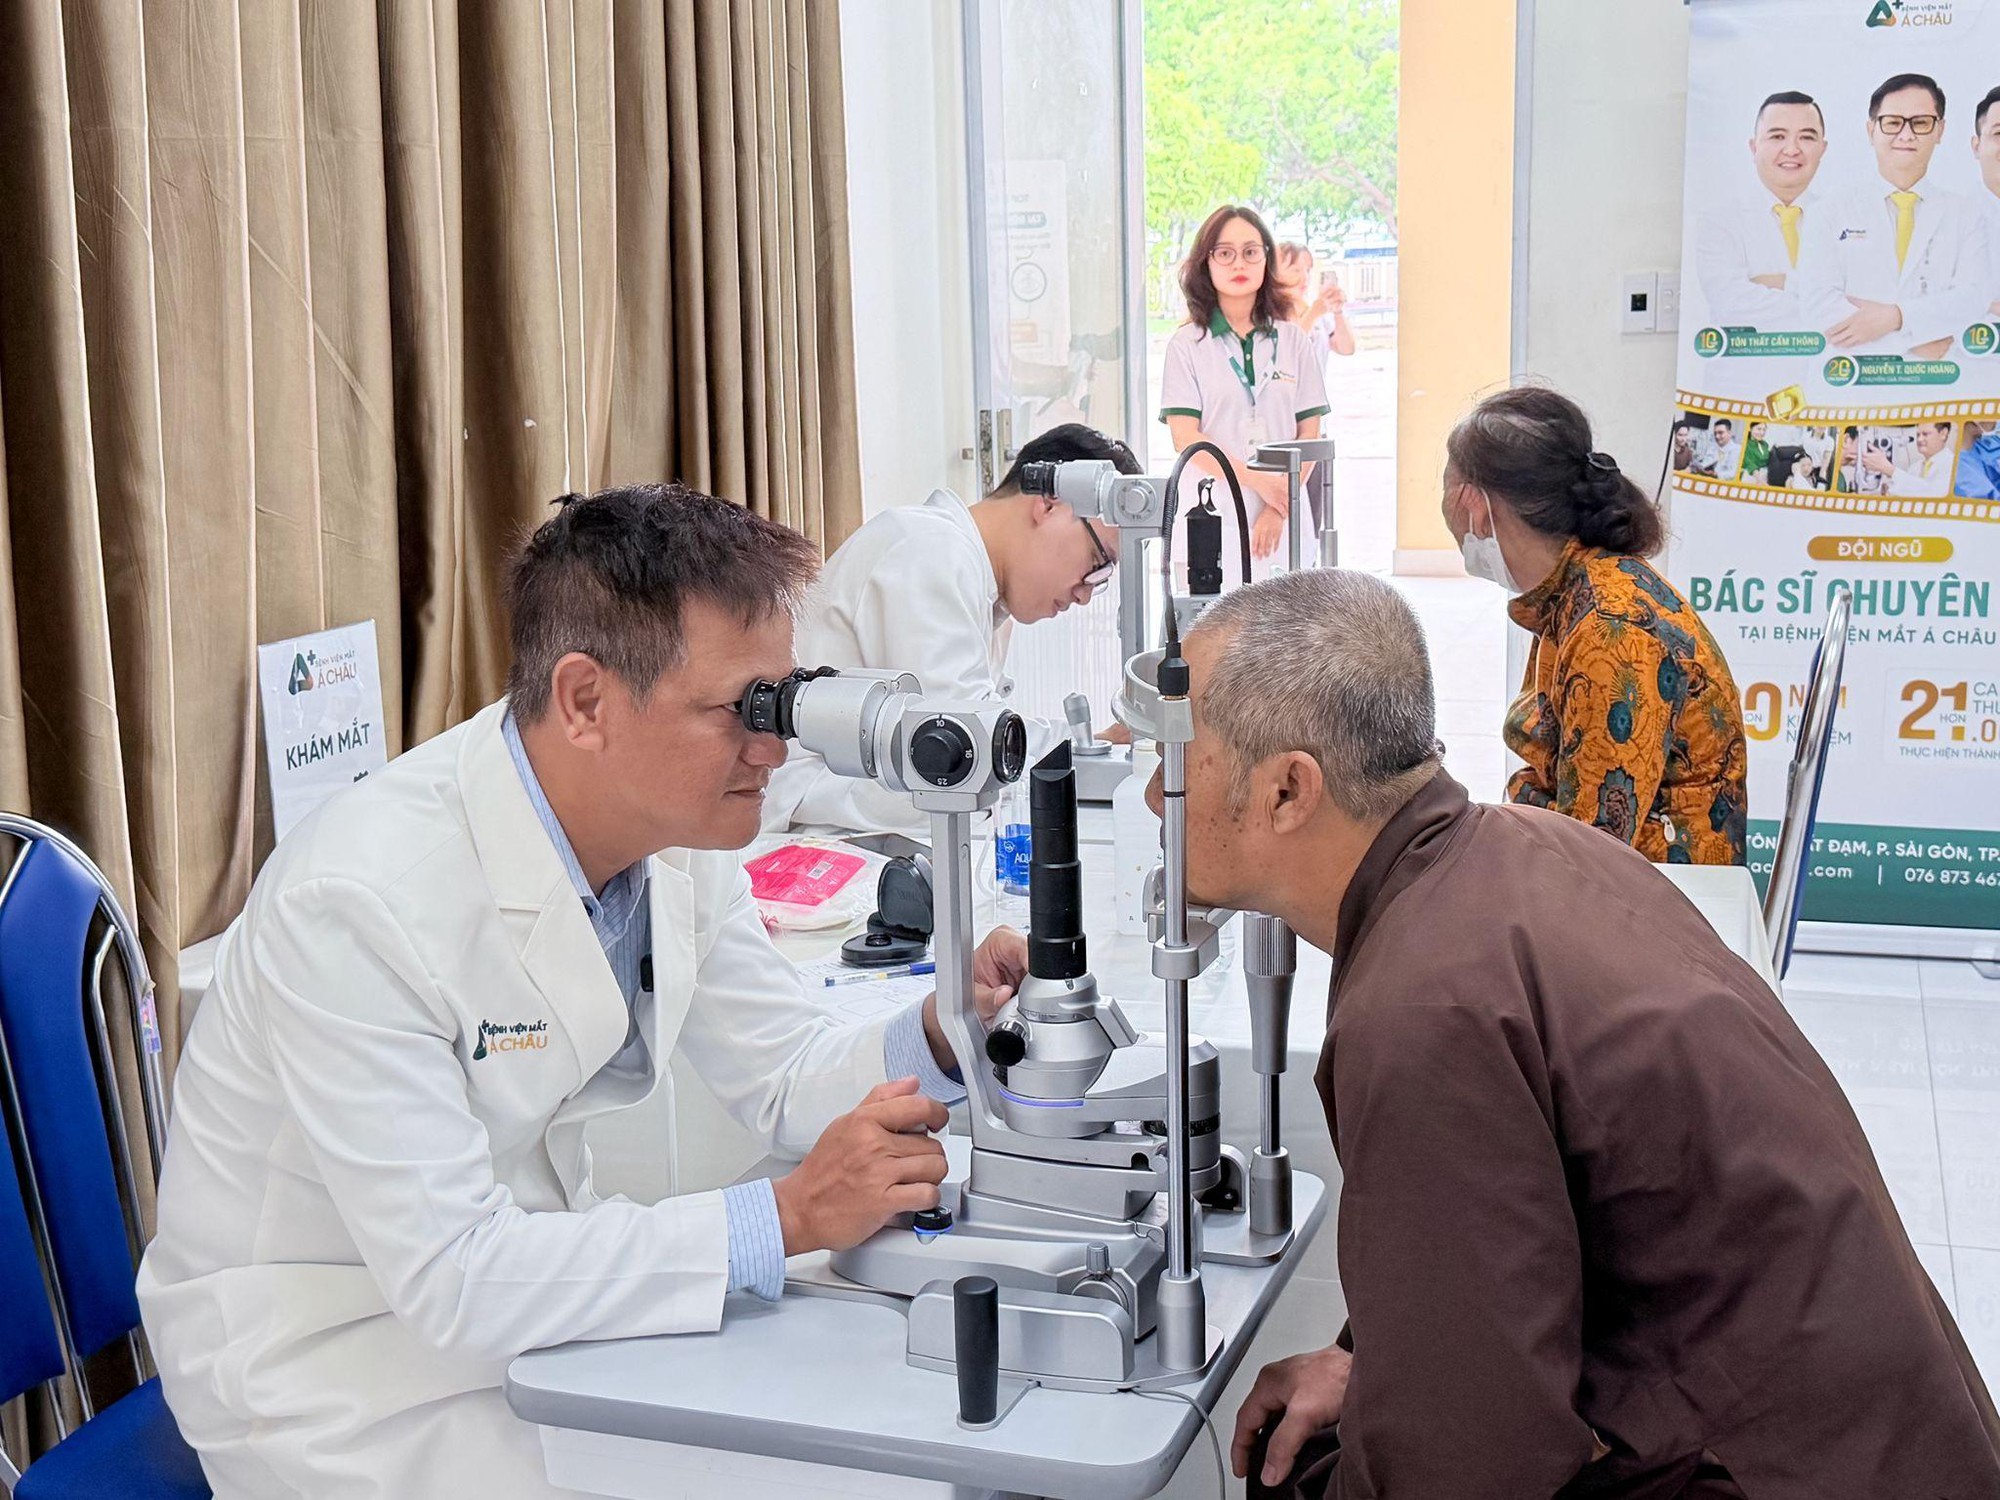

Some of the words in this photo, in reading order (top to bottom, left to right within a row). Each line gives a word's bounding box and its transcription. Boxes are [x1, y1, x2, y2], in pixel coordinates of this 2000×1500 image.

[1913, 11, 1952, 26] CHÂU
[1838, 538, 1873, 560] ĐỘI
[1880, 539, 1923, 558] NGŨ
[1690, 569, 1765, 613] BÁC
[1776, 570, 1818, 614] SĨ
[1739, 625, 1766, 643] TẠI
[1774, 623, 1821, 644] BỆNH
[1878, 624, 1916, 644] MẮT
[1923, 626, 1935, 643] Á
[1943, 628, 1996, 645] CHÂU
[318, 669, 326, 688] Á
[327, 662, 357, 685] CHÂU
[1973, 682, 1998, 697] CA
[1744, 682, 1782, 742] 0
[935, 719, 945, 727] 10
[286, 733, 334, 770] KHÁM
[338, 716, 370, 753] MẮT
[1933, 747, 1959, 759] HIỆN
[937, 777, 948, 785] 25
[1828, 839, 1871, 857] ĐẠM,
[1877, 842, 1890, 856] P.
[1895, 840, 1923, 858] SÀI
[1928, 842, 1972, 862] GÒN,
[1905, 867, 1935, 883] 076
[1940, 870, 1970, 885] 873
[509, 1022, 527, 1035] VIỆN
[529, 1019, 547, 1032] MẮT
[499, 1033, 548, 1051] CHÂU
